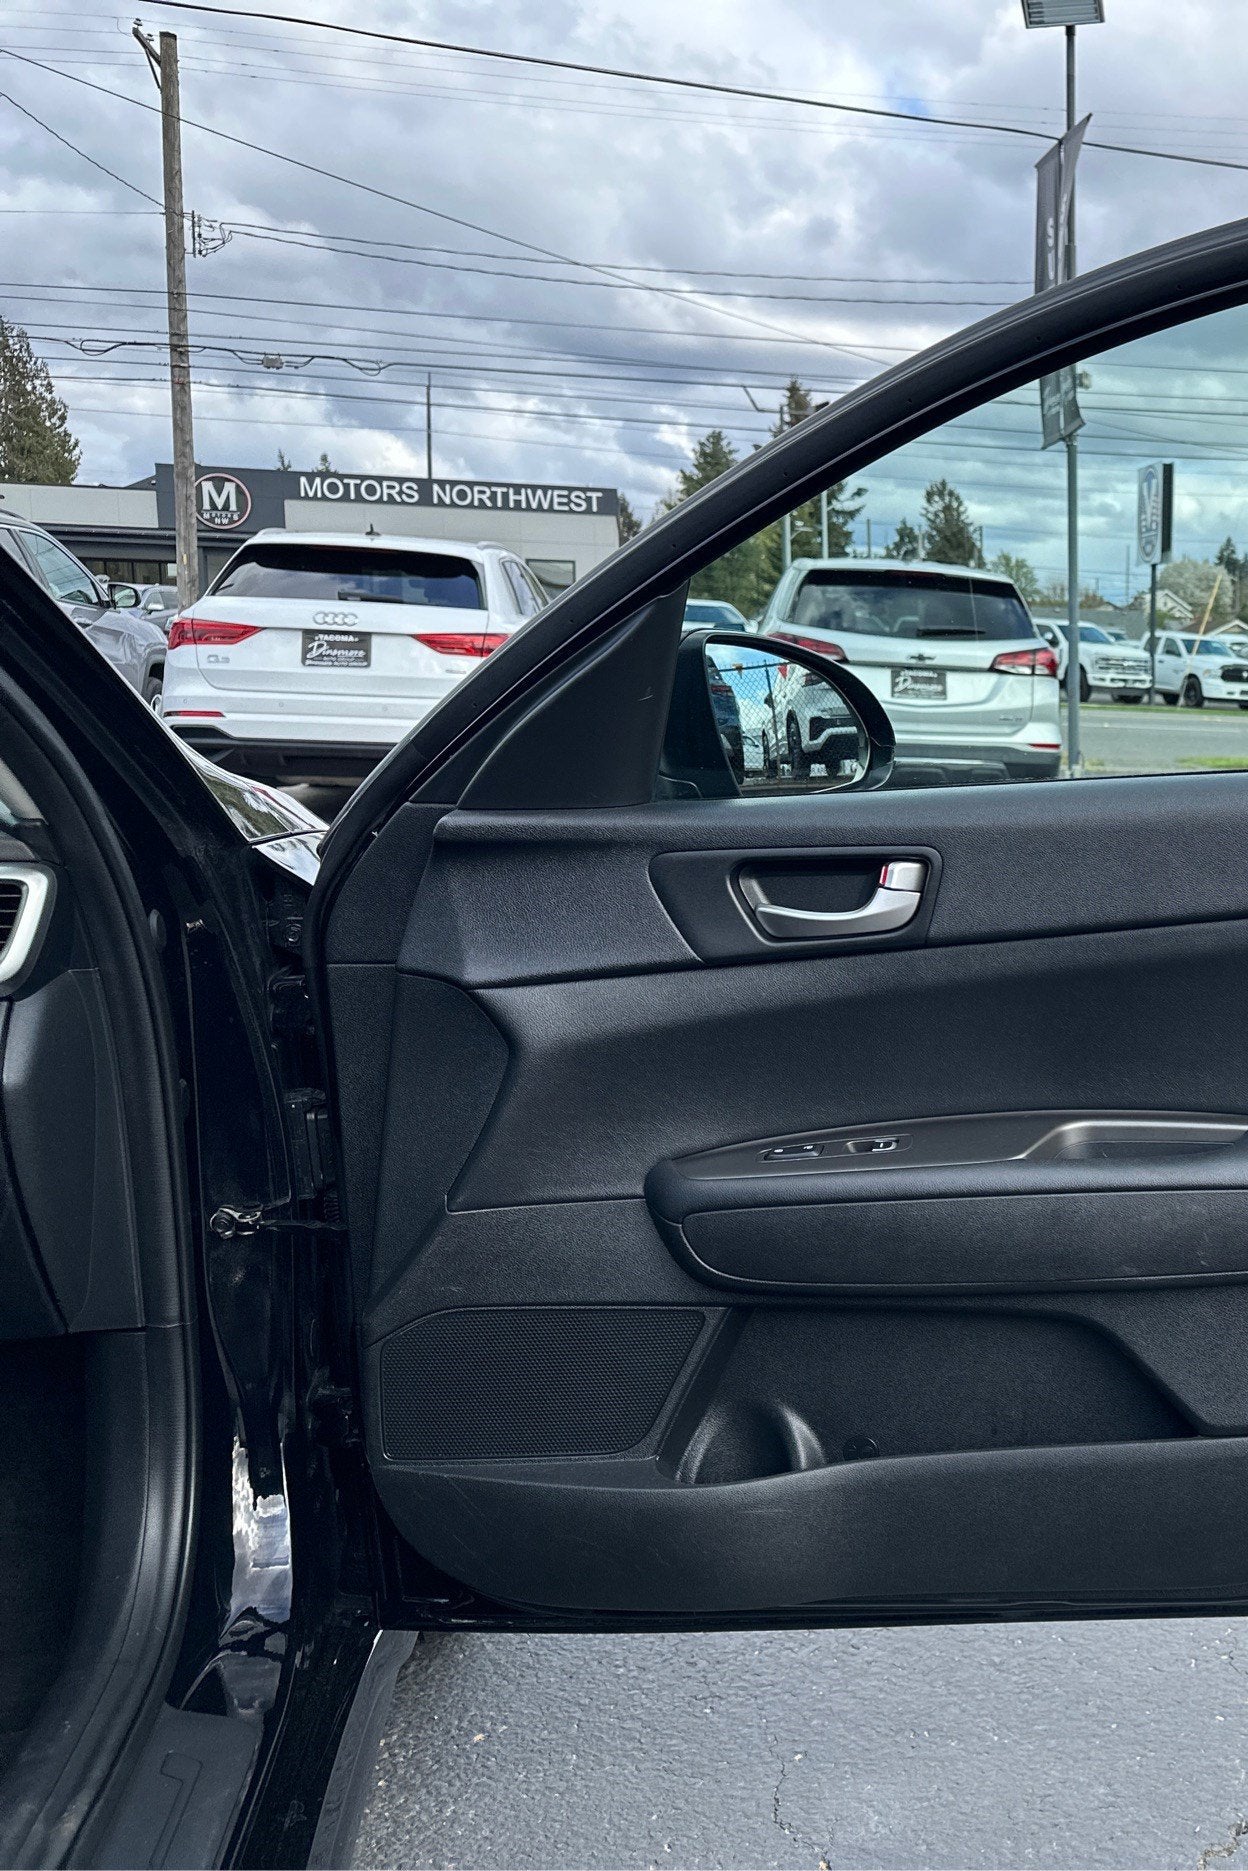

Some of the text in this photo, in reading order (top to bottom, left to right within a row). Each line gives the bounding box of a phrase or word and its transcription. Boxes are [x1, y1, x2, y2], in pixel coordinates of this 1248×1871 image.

[201, 480, 238, 511] M
[299, 476, 604, 513] MOTORS NORTHWEST
[214, 517, 229, 525] NW
[318, 633, 355, 642] TACOMA
